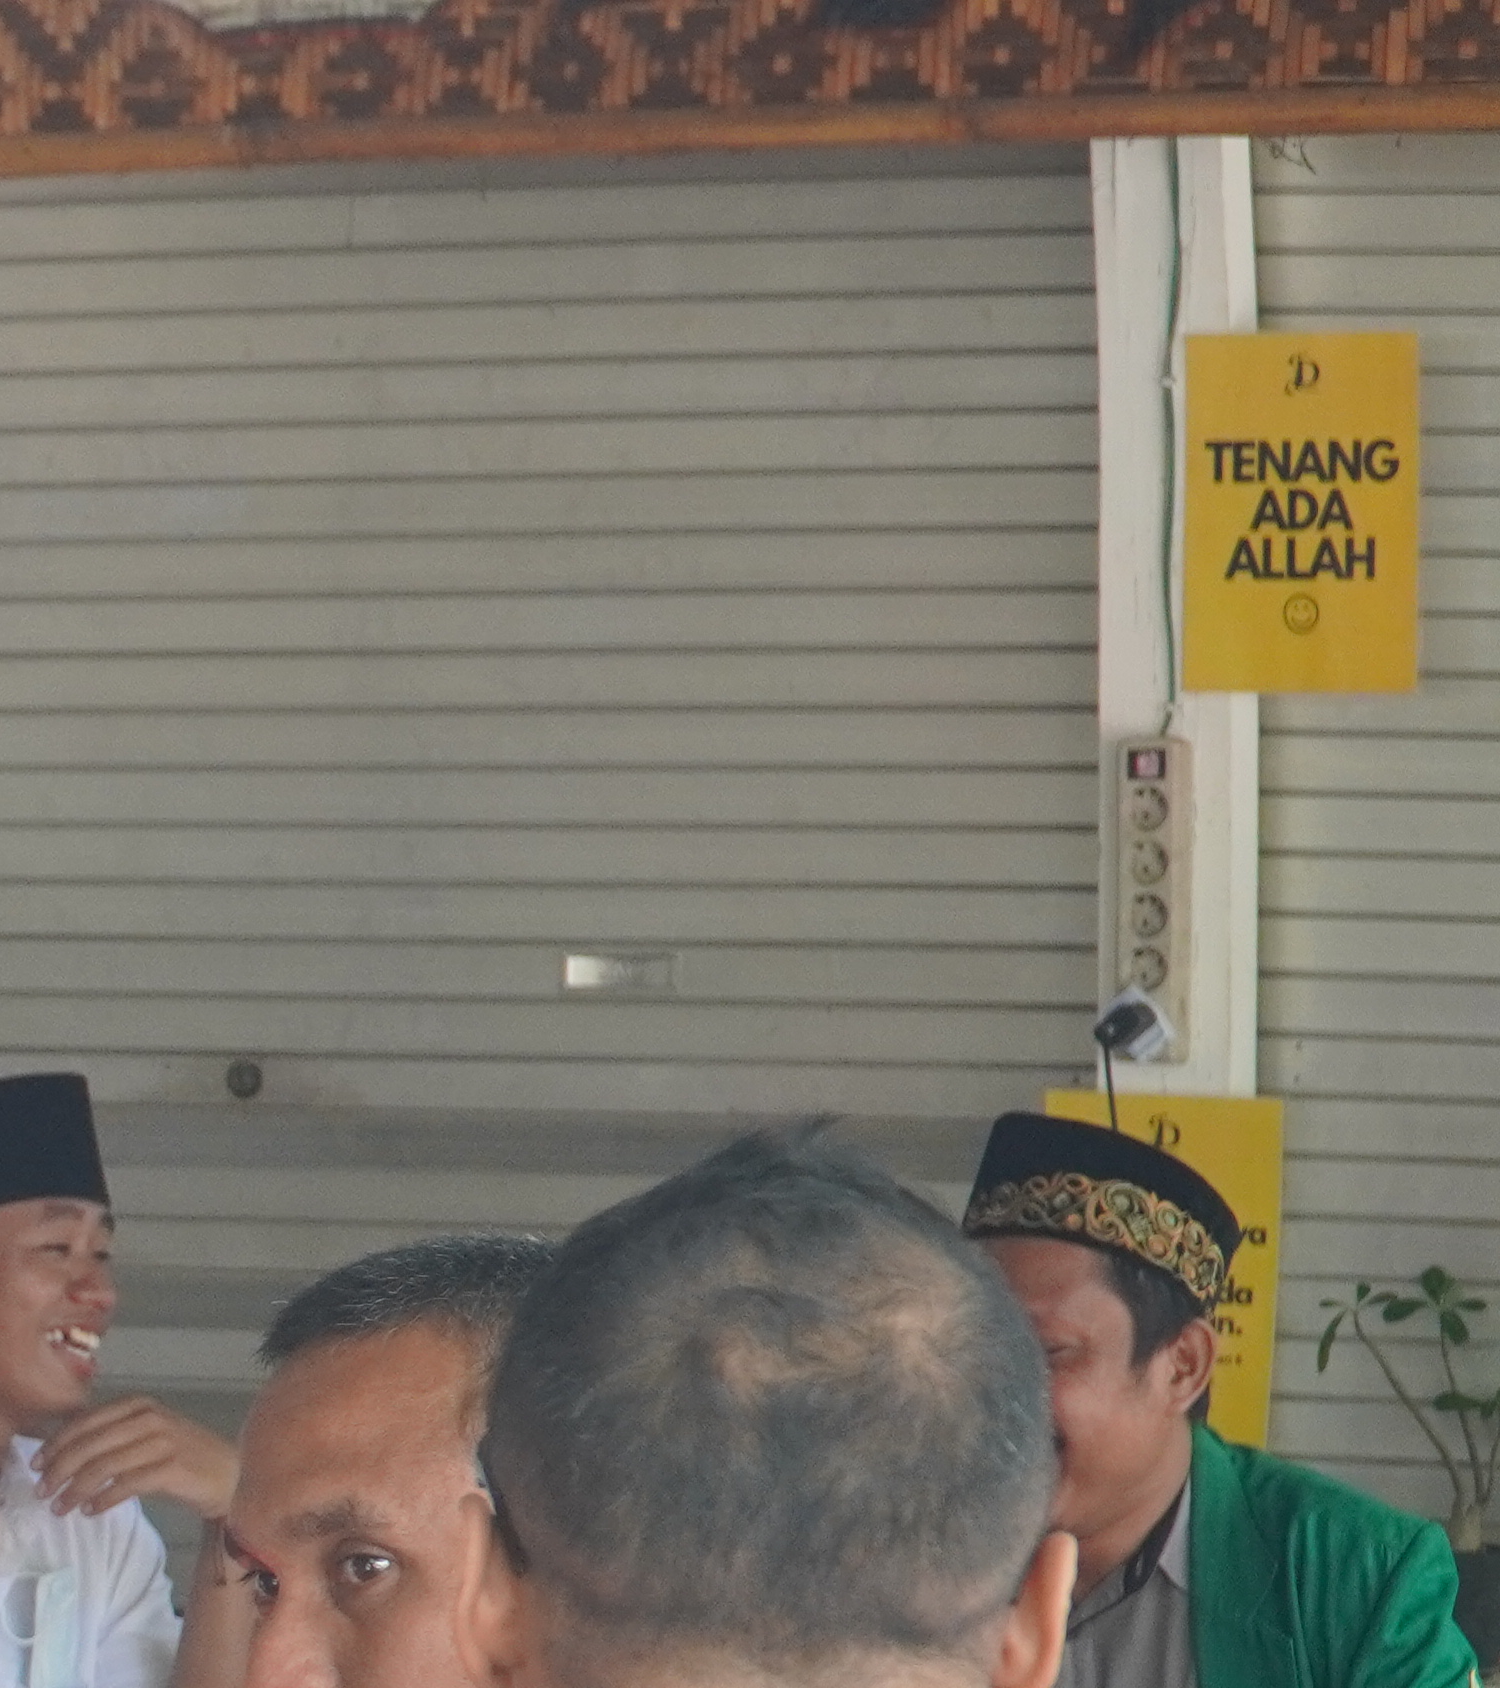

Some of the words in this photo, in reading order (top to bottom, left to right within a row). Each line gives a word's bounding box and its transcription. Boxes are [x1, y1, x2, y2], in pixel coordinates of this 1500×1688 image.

[1204, 439, 1400, 484] TENANG
[1250, 487, 1353, 532] ADA
[1225, 536, 1377, 581] ALLAH
